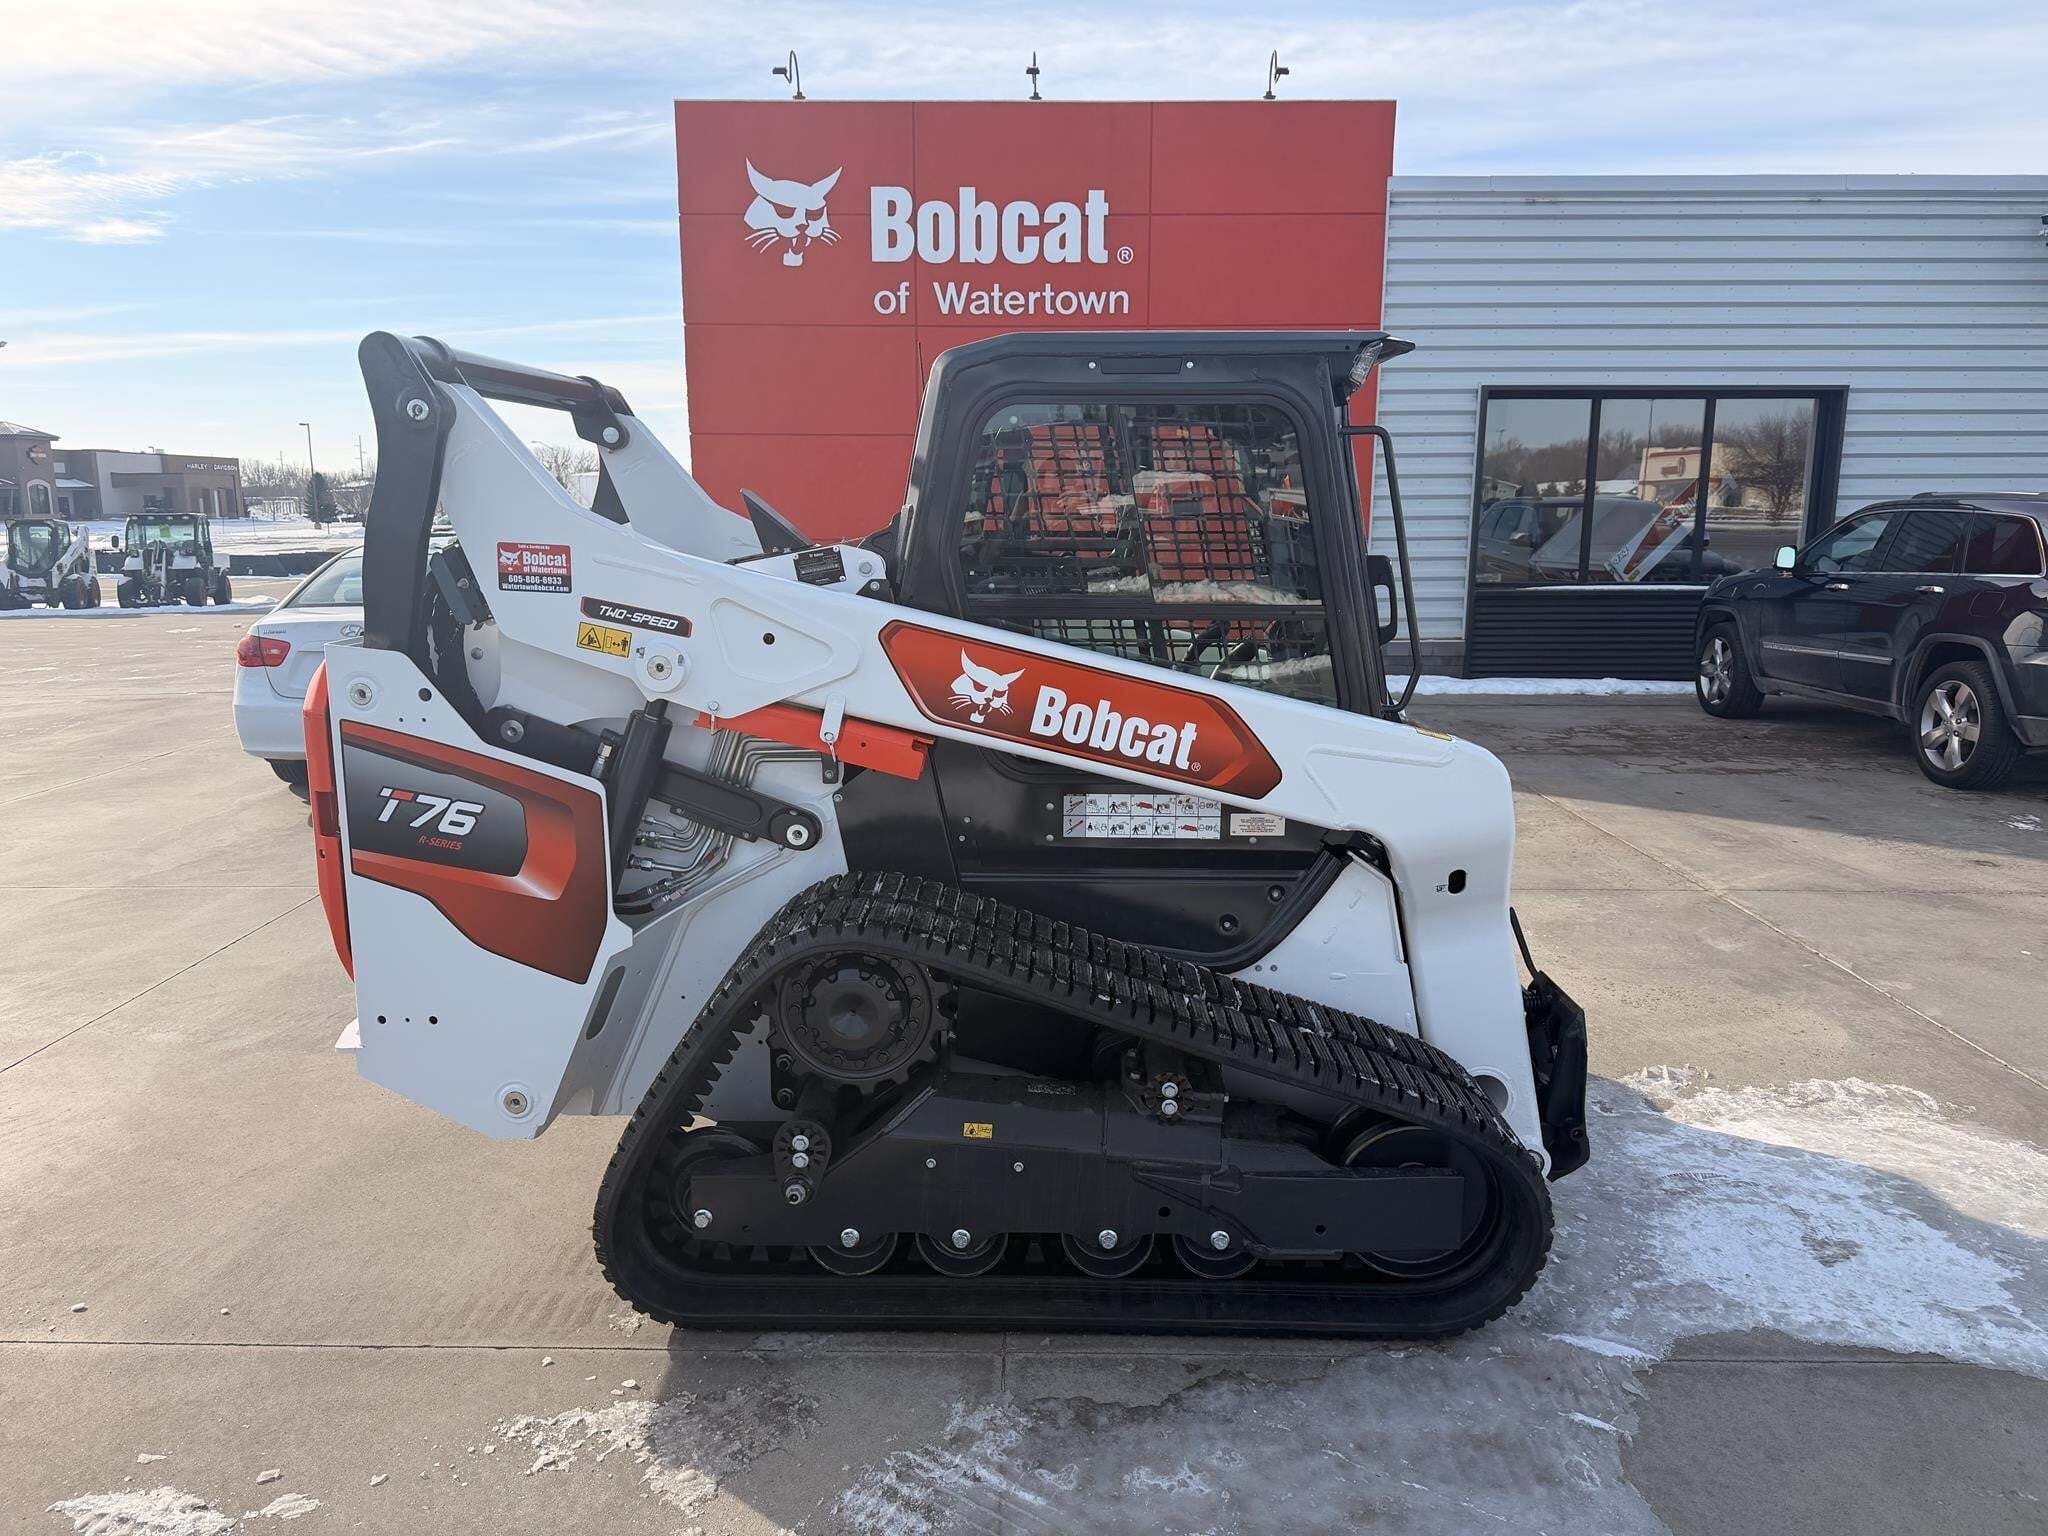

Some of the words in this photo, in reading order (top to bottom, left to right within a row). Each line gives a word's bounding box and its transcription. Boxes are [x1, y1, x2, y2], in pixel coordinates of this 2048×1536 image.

[870, 186, 1109, 264] Bobcat
[874, 282, 910, 314] of
[933, 282, 1129, 314] Watertown
[522, 551, 567, 566] Bobcat
[523, 565, 530, 573] of
[531, 566, 567, 575] Watertown
[600, 605, 678, 630] TWO-SPEED
[1030, 685, 1197, 770] Bobcat
[378, 787, 485, 836] T76
[418, 835, 462, 850] R-SERIES
